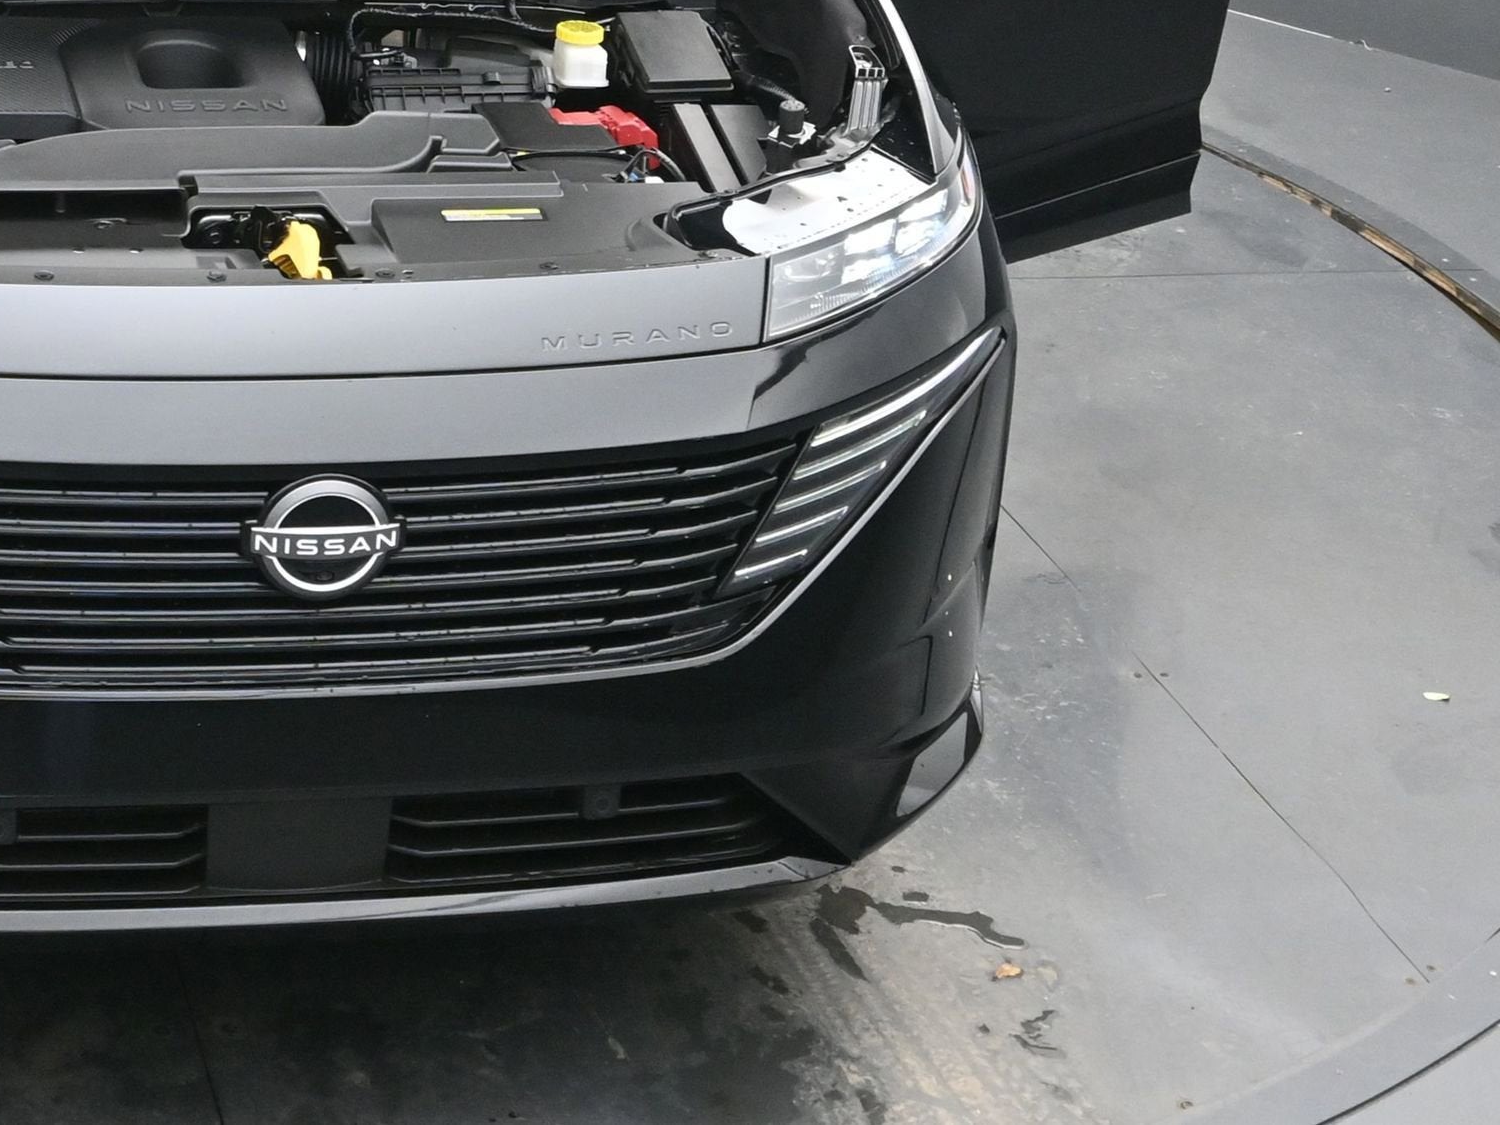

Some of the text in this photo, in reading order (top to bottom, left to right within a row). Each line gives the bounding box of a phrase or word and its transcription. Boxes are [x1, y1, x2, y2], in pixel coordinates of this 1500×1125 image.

[124, 98, 289, 113] NISSAN
[541, 322, 735, 352] MURANO
[254, 530, 398, 556] NISSAN
